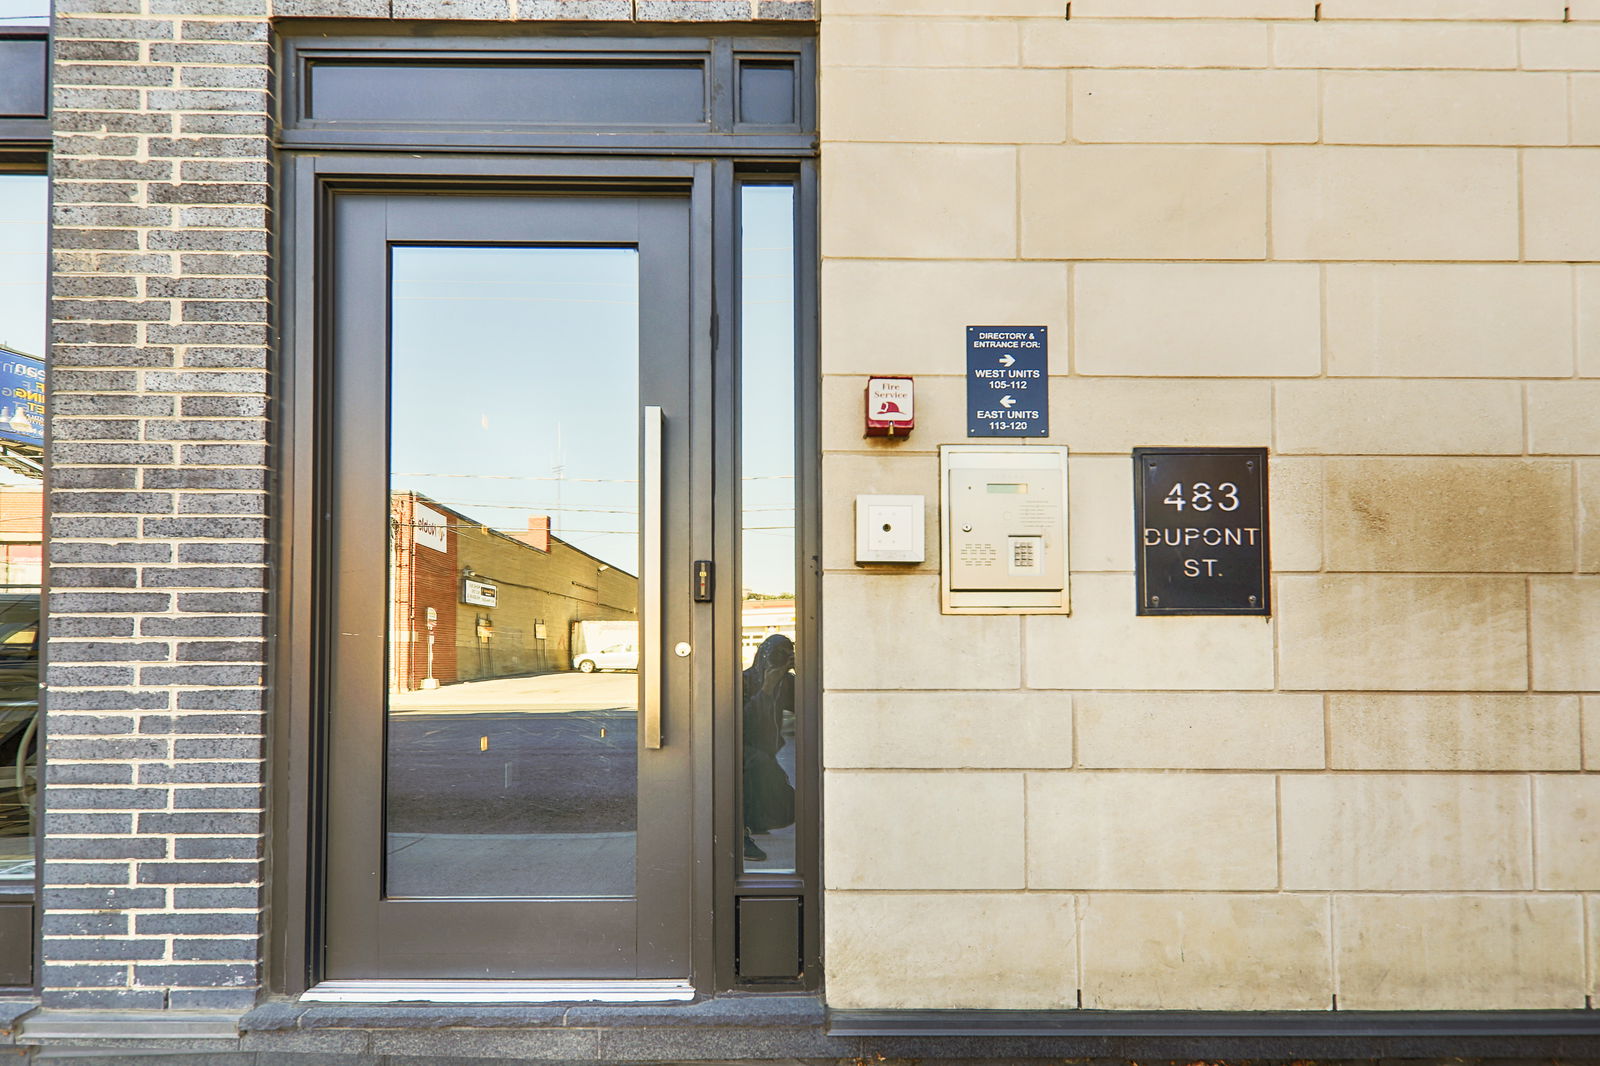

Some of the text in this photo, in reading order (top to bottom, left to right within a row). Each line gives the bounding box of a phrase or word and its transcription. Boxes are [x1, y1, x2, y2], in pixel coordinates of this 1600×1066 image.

[979, 332, 1035, 341] DIRECTORY &
[973, 340, 1041, 349] ENTRANCE FOR:
[975, 369, 1041, 379] WEST UNITS
[882, 383, 901, 391] Fire
[989, 380, 1028, 390] 105-112
[874, 391, 908, 399] Service
[976, 410, 1040, 419] EAST UNITS
[989, 421, 1028, 430] 113-120
[1163, 482, 1239, 512] 483
[1144, 528, 1260, 546] DUPONT
[1183, 558, 1223, 578] ST.
